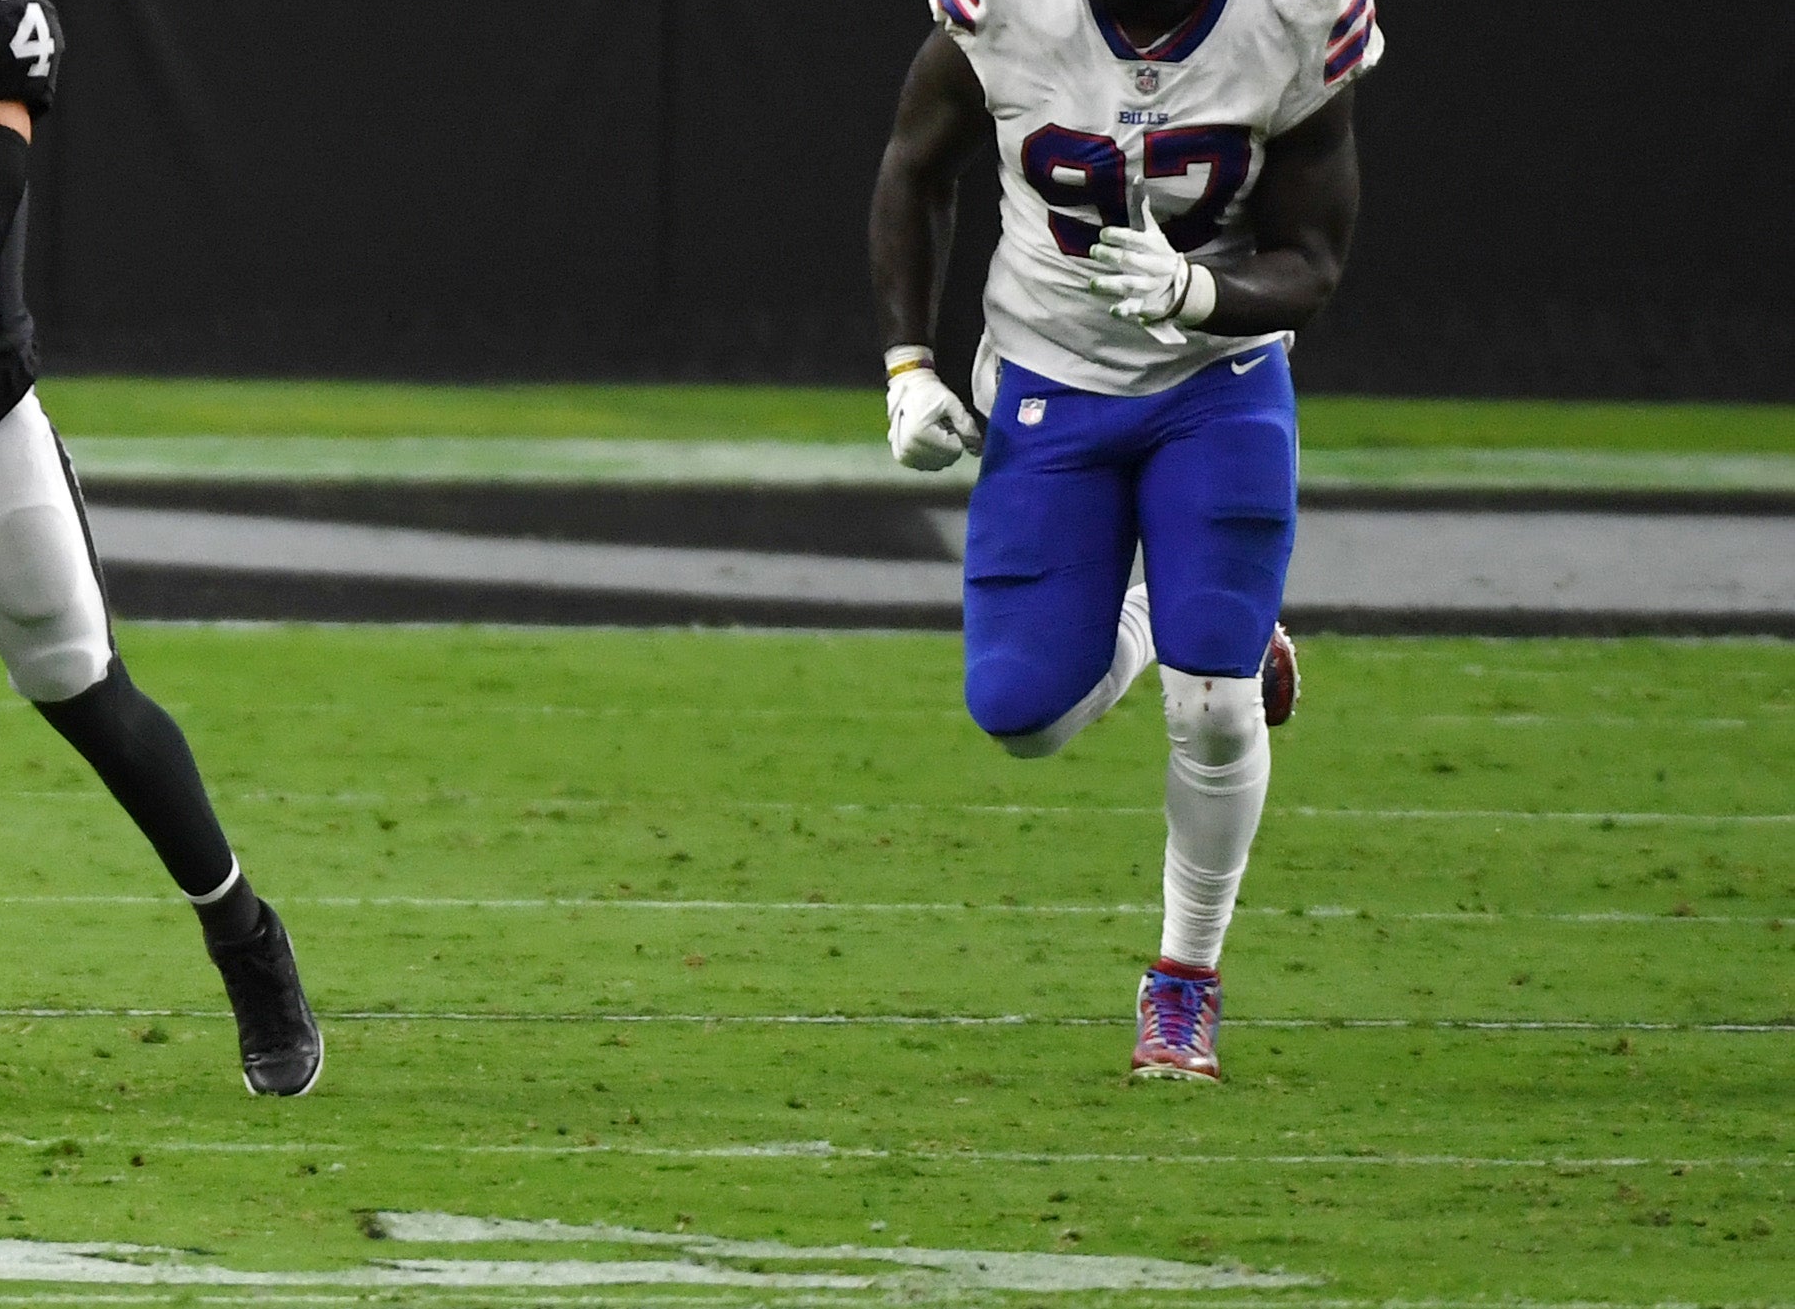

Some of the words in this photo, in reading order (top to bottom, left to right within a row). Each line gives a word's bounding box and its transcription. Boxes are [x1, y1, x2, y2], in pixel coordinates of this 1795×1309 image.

[9, 2, 55, 77] 4
[1118, 111, 1169, 125] BILLS
[1023, 123, 1251, 258] 97
